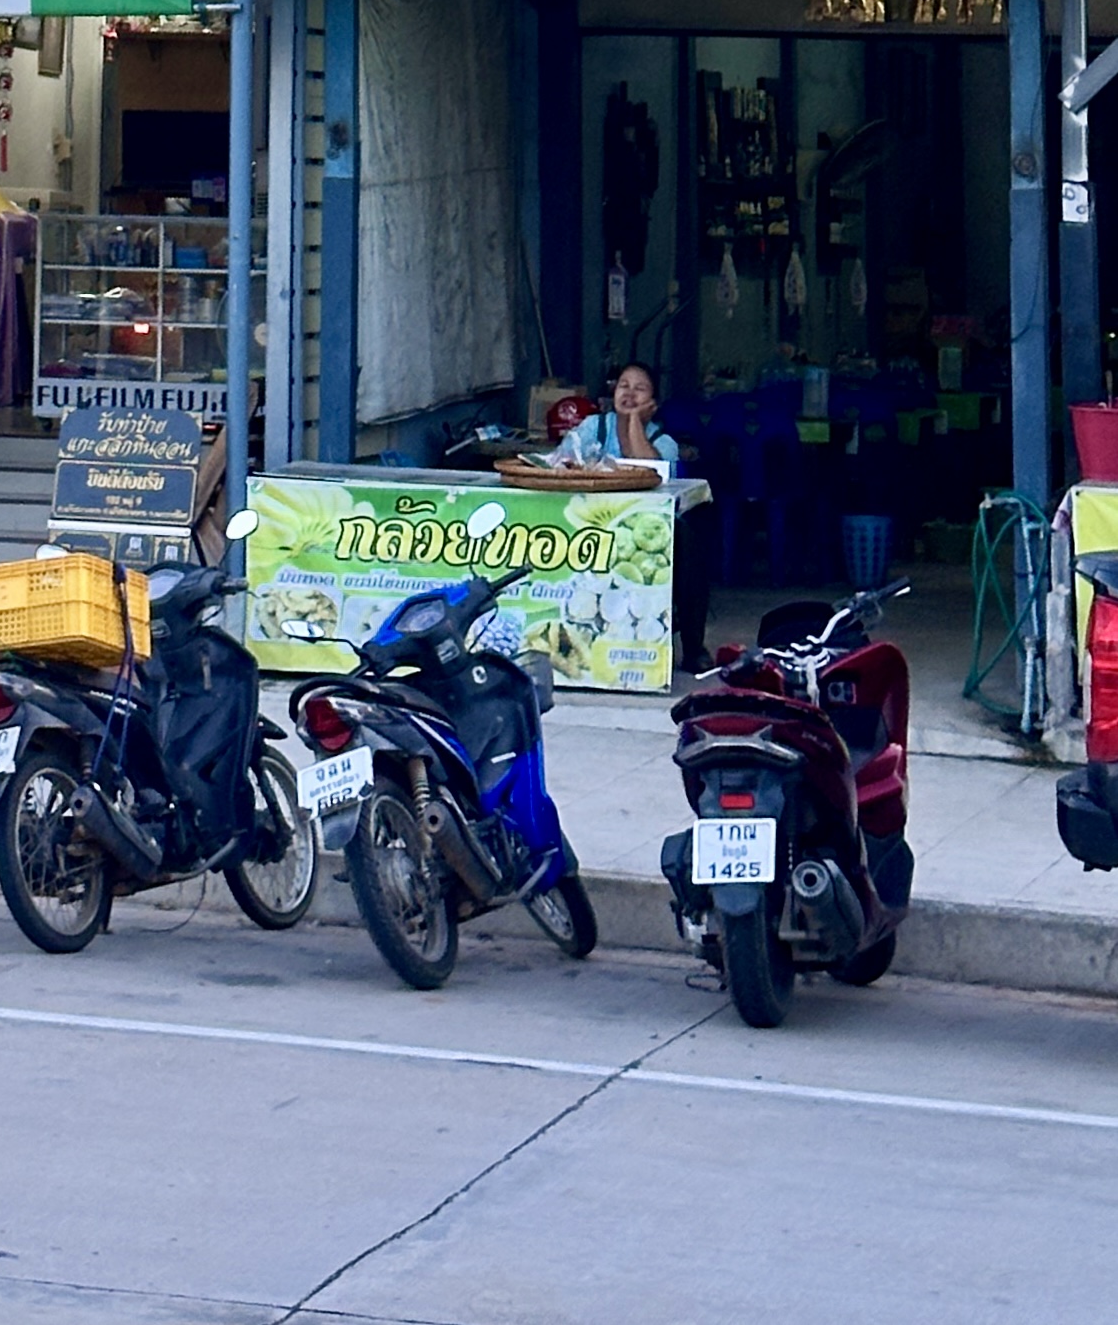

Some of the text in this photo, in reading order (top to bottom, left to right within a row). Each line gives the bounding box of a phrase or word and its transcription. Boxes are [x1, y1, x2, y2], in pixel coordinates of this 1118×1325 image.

[335, 496, 616, 573] กล้วยทอด
[708, 861, 762, 879] 1425
